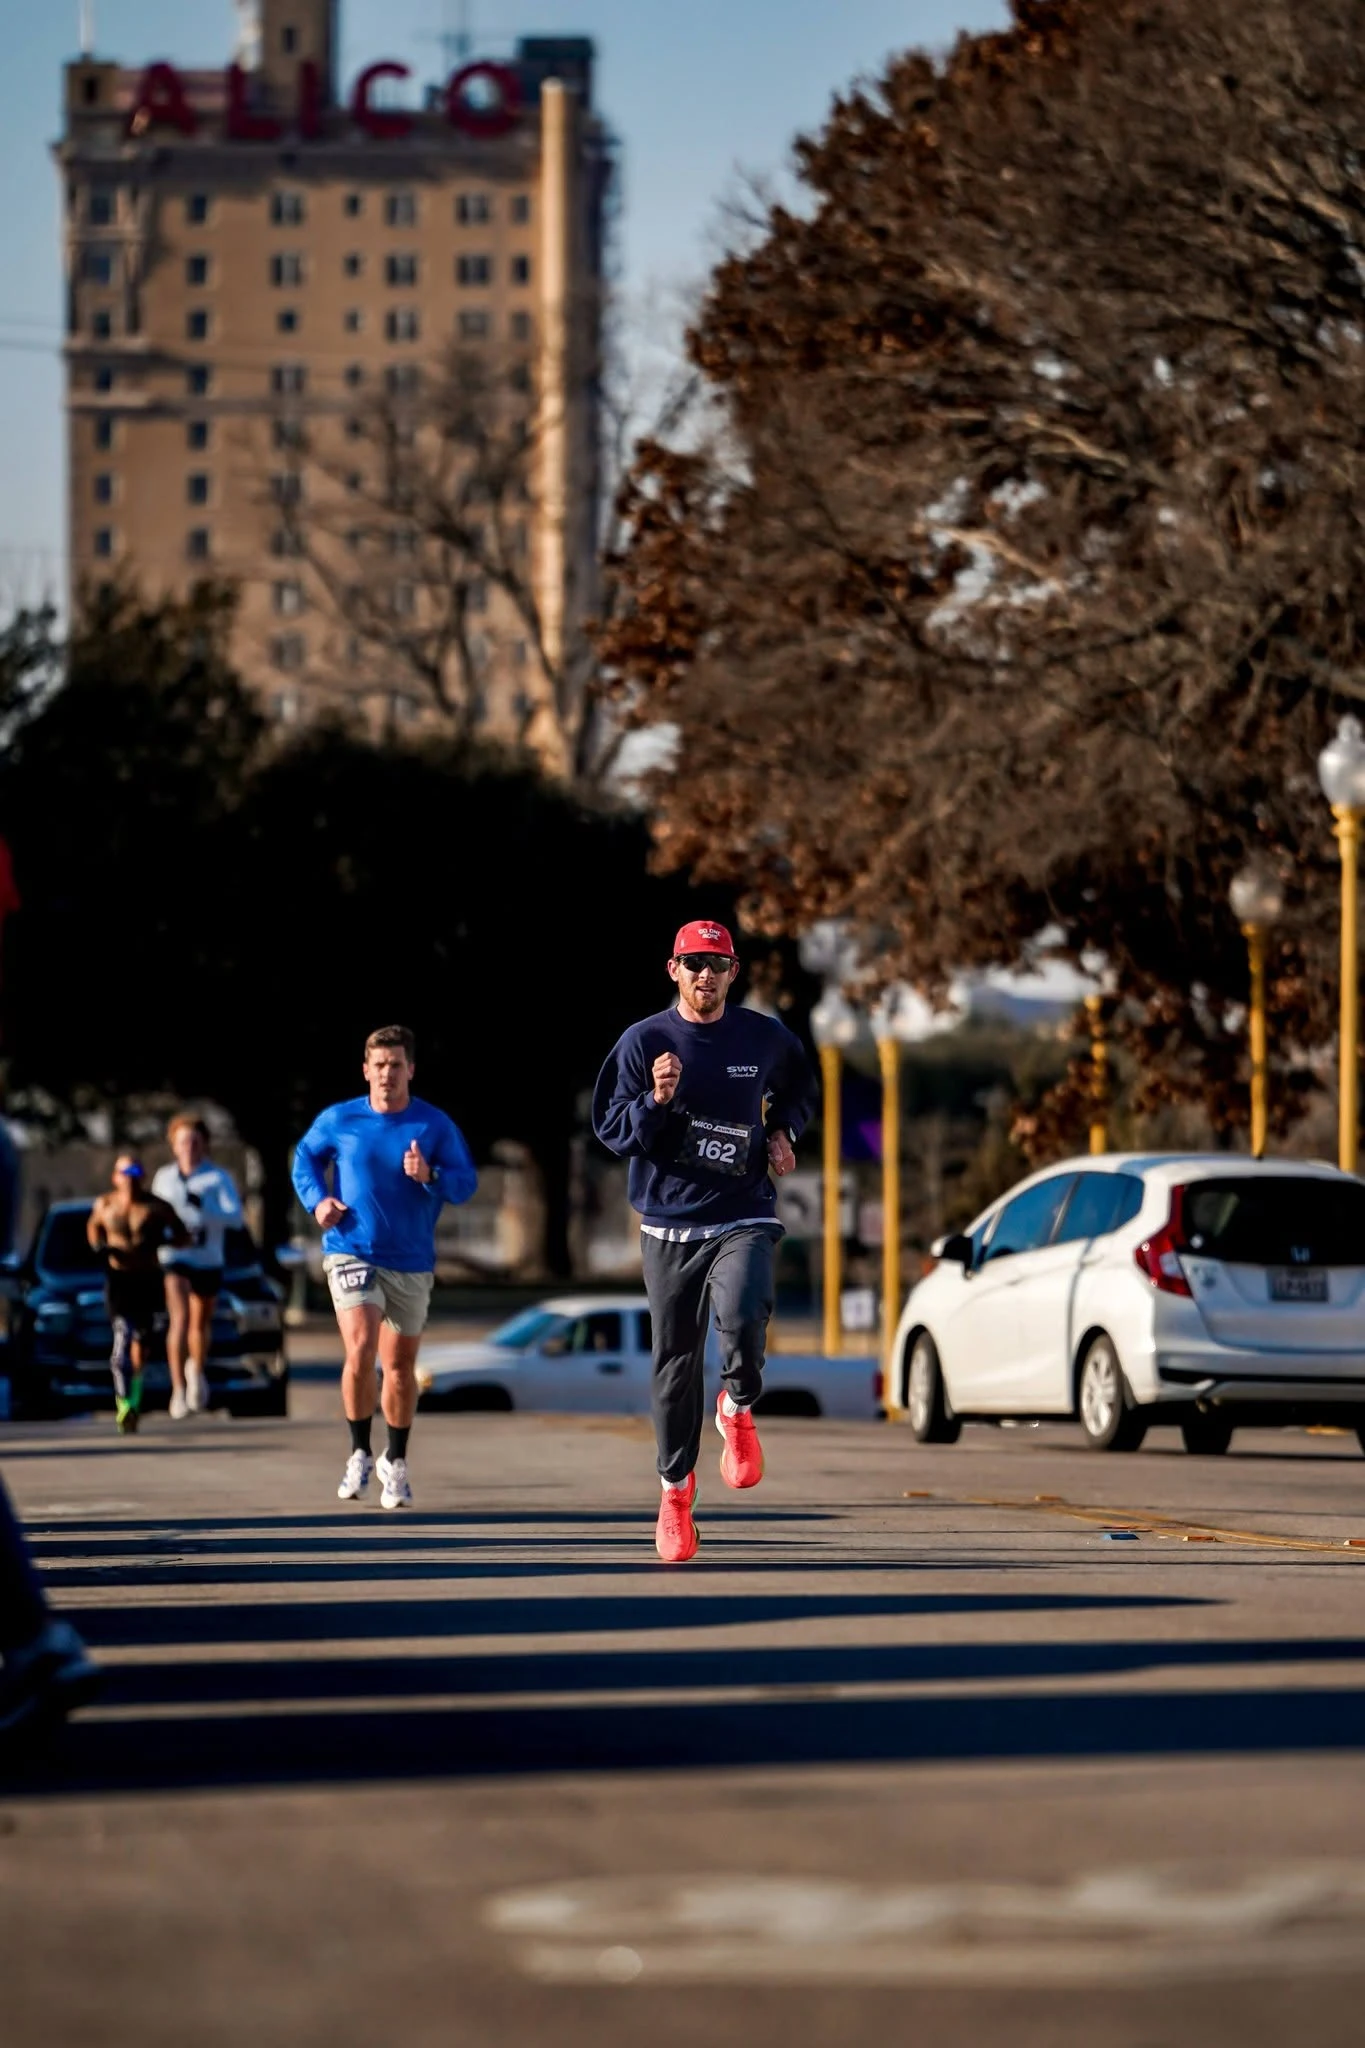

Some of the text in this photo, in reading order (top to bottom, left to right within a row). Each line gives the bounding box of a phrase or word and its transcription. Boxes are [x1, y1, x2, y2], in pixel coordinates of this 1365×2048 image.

[127, 60, 524, 138] ALICO
[726, 1065, 759, 1073] SWC
[691, 1119, 713, 1131] WACO
[696, 1138, 737, 1164] 162
